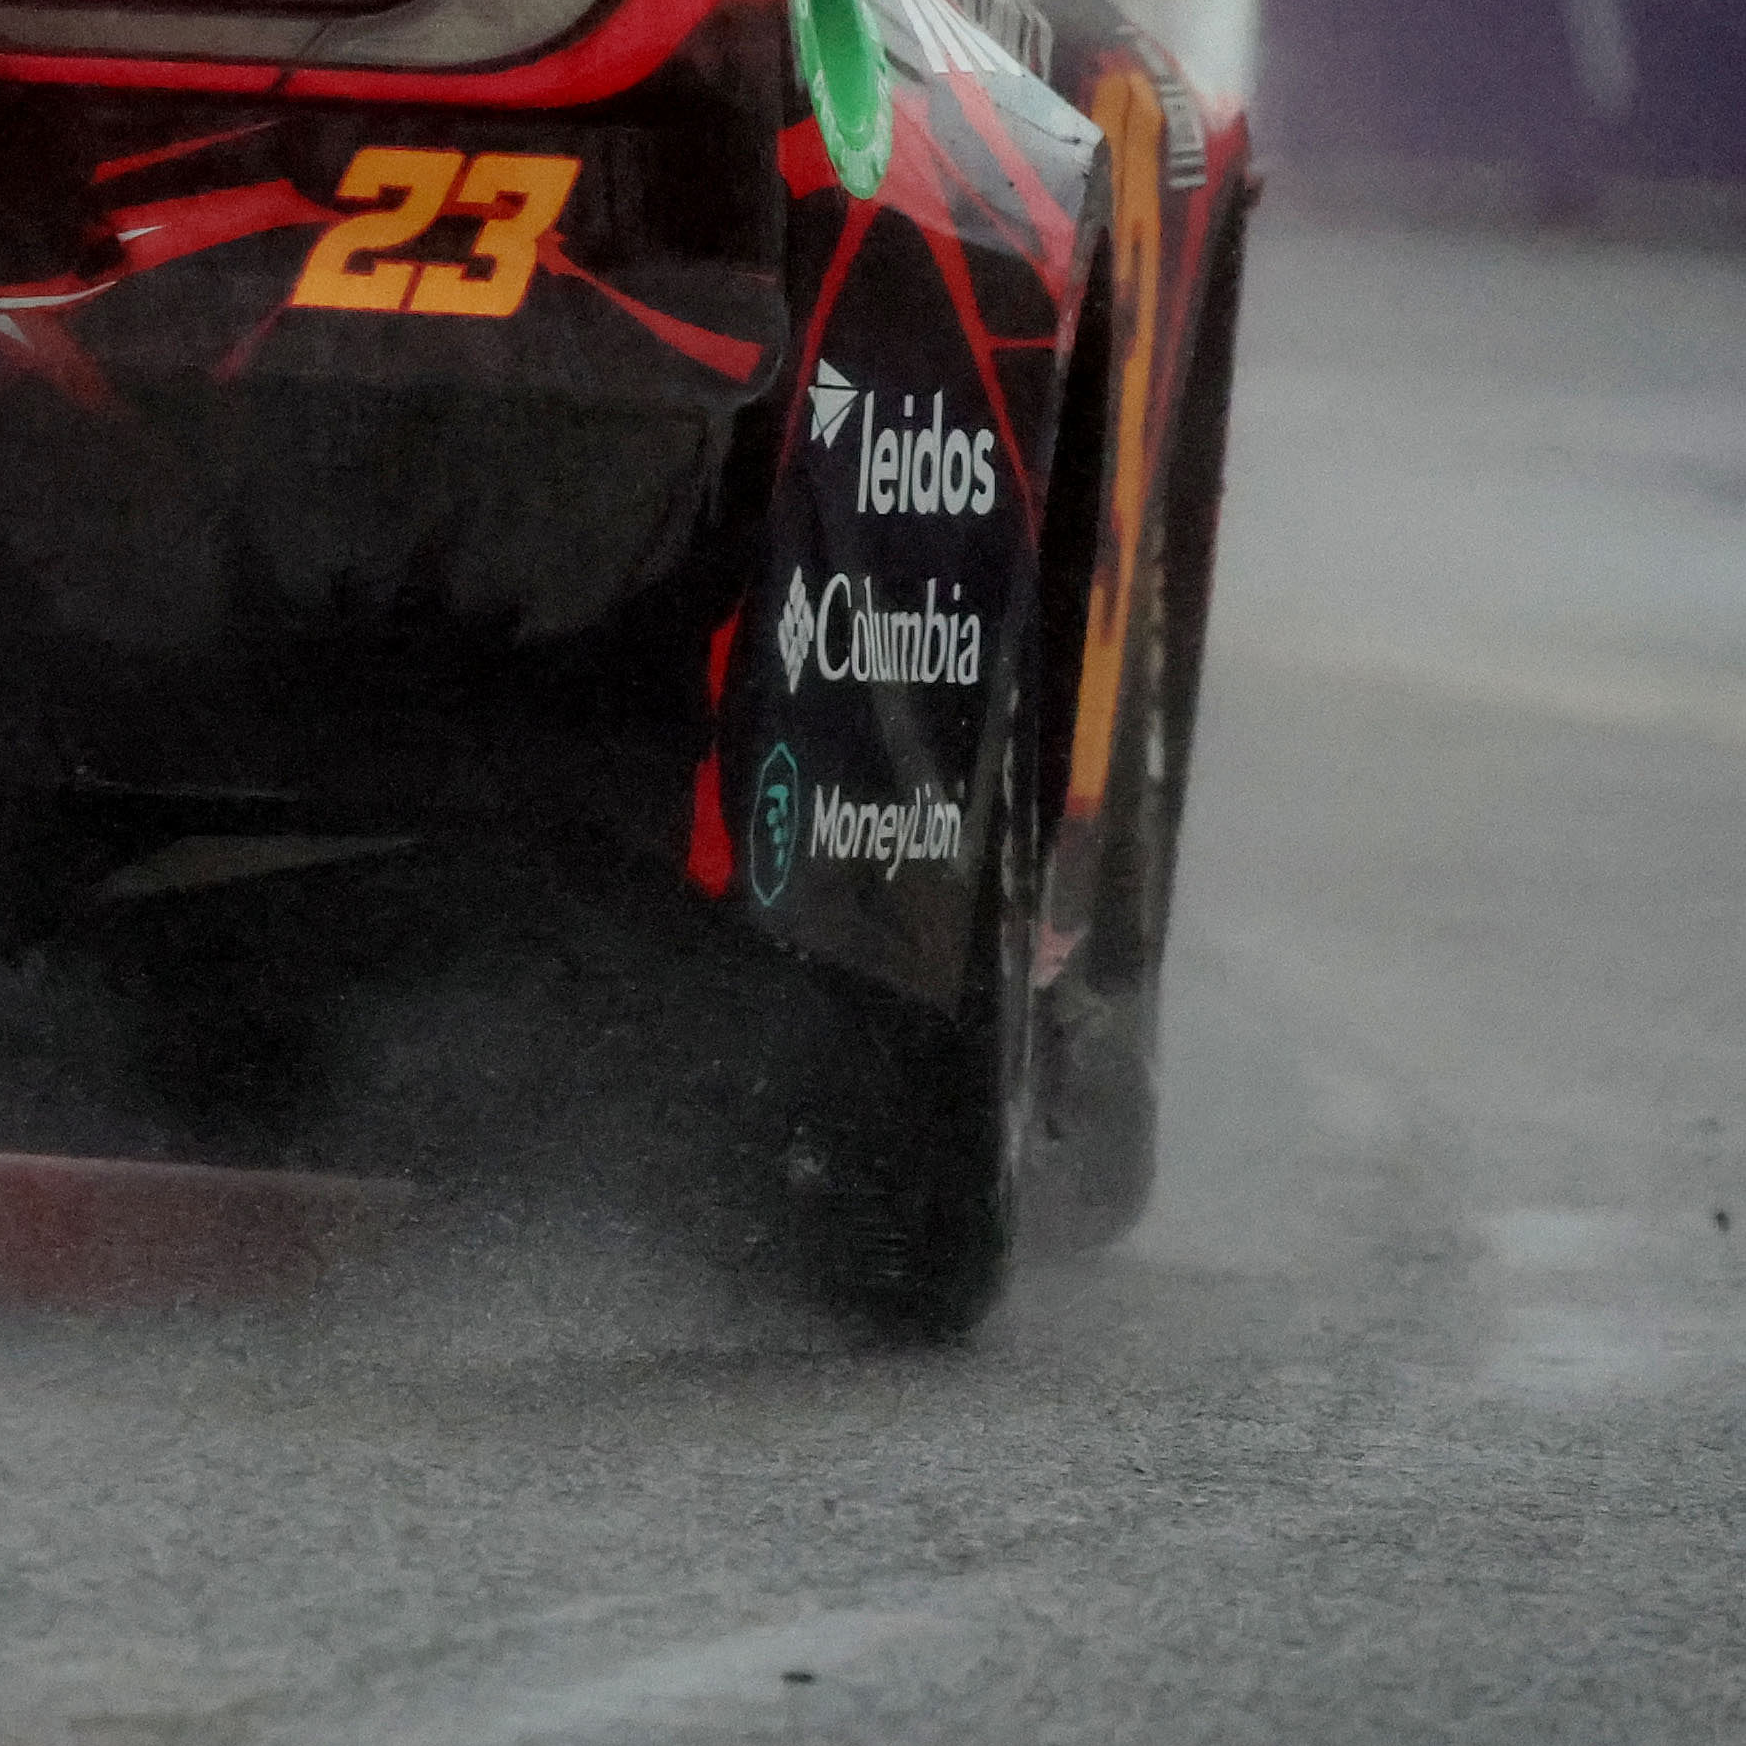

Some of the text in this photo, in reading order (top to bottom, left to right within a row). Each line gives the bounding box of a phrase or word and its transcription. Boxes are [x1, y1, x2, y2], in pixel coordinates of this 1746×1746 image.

[289, 144, 582, 318] 23
[857, 389, 997, 516] leidos
[816, 572, 981, 686] Columbia
[809, 783, 962, 882] MoneyLion
